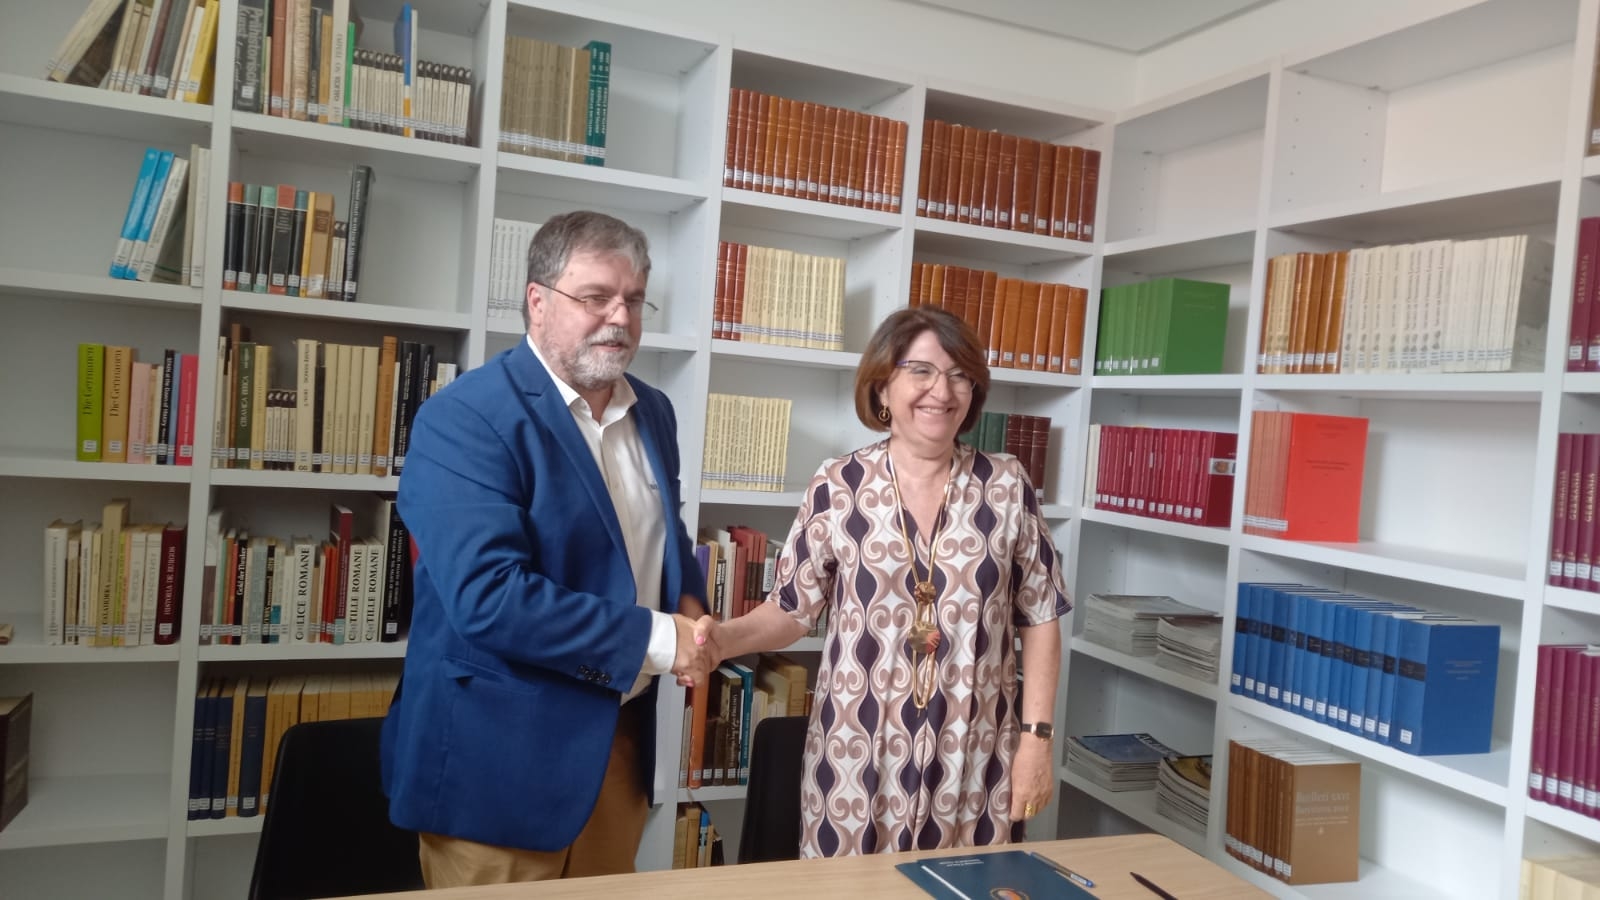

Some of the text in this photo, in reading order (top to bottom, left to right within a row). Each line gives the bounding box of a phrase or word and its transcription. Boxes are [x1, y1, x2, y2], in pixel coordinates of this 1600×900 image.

[82, 400, 93, 415] Die
[109, 349, 122, 417] Die Germanen
[164, 585, 174, 615] HISTORIA
[166, 573, 174, 583] DE
[236, 581, 245, 596] Gold
[295, 547, 310, 641] GLICE ROMANE
[349, 549, 363, 641] CTILLE ROMANE
[366, 549, 380, 641] CTILLE ROMANE
